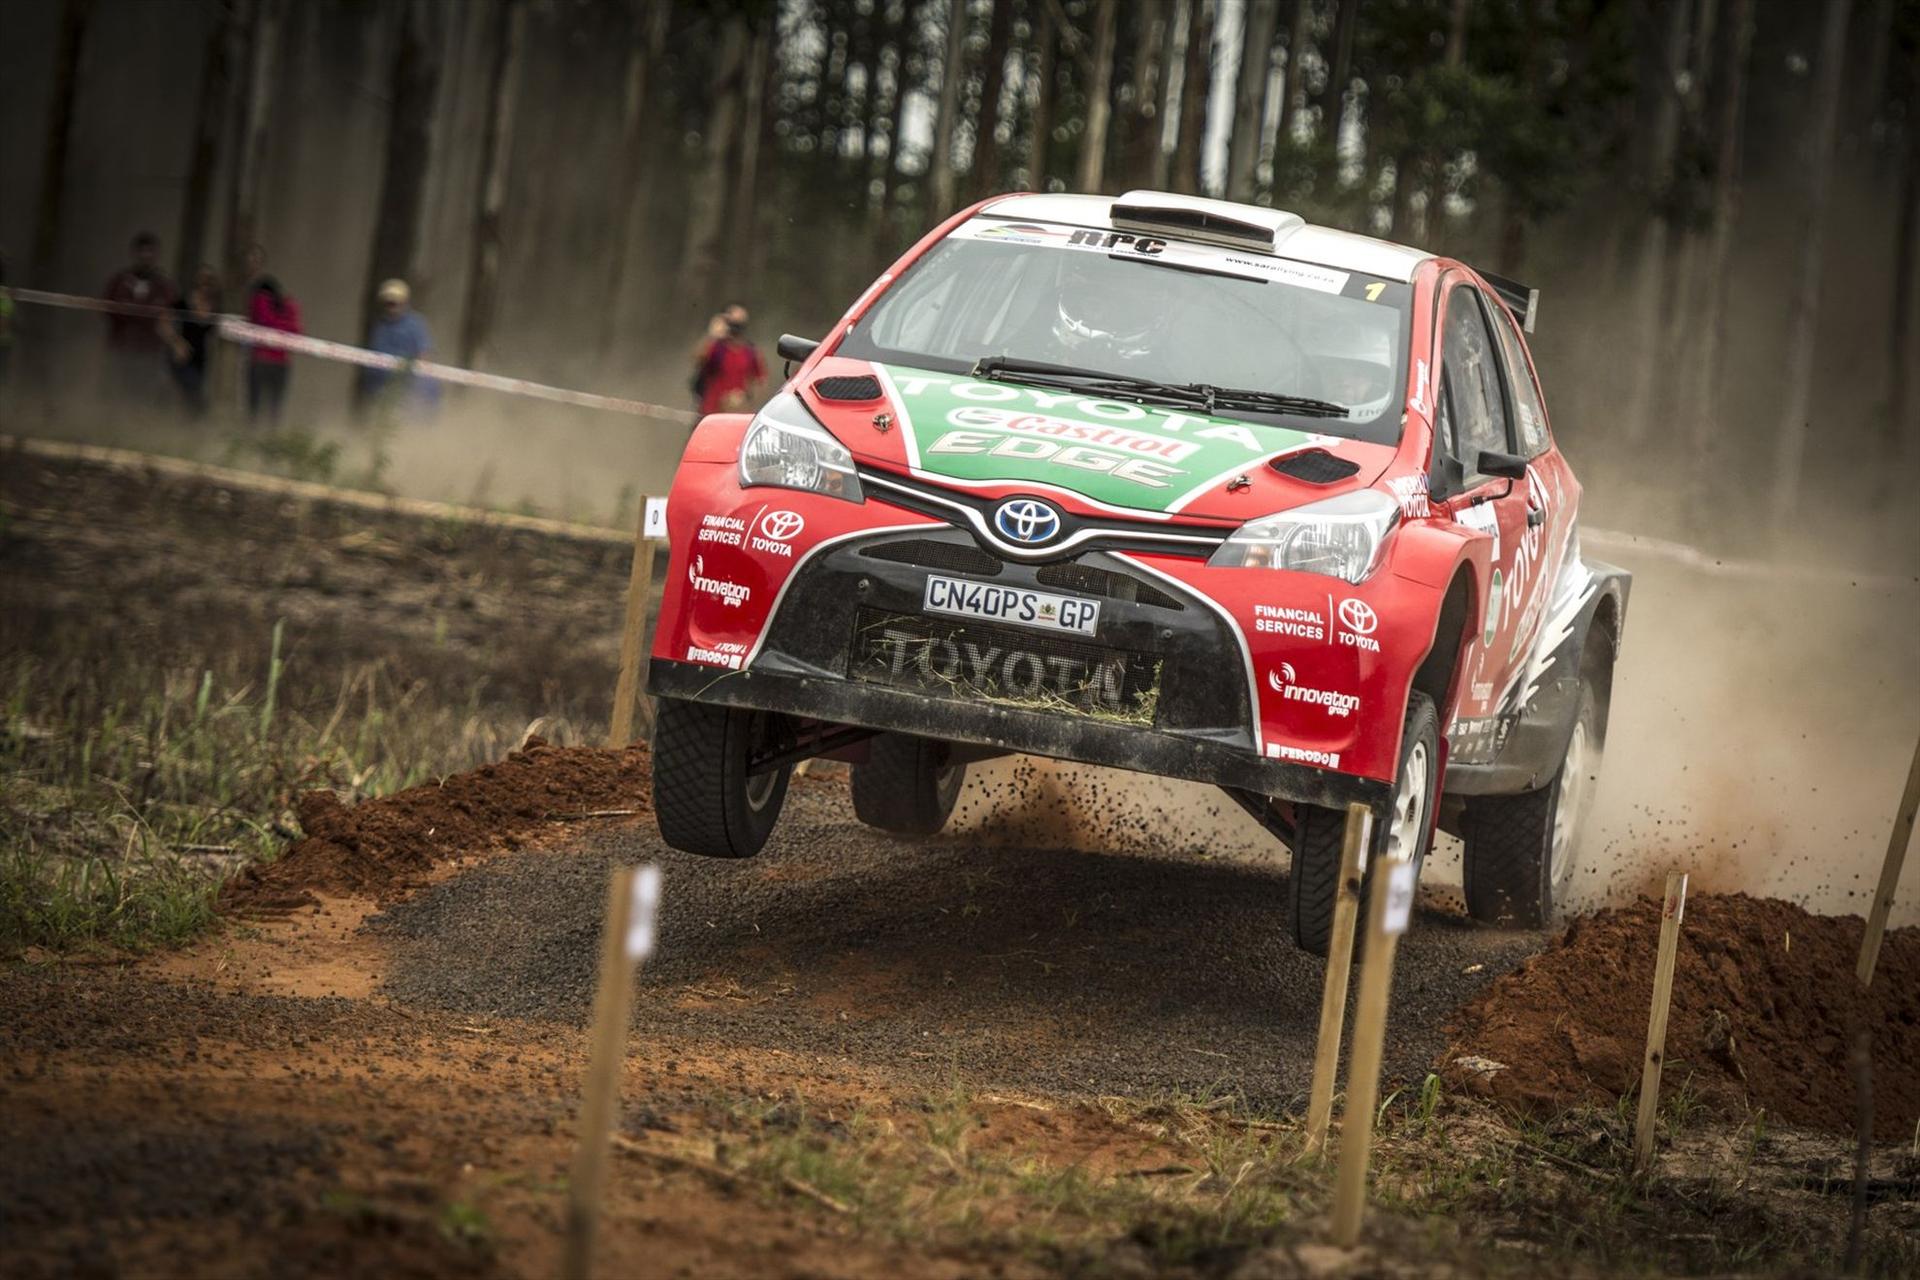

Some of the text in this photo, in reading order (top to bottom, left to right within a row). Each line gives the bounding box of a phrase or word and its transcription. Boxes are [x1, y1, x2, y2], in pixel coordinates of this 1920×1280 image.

[1364, 282, 1387, 302] 1
[893, 375, 1264, 452] TOYOTA
[1006, 414, 1184, 458] Castrol
[927, 430, 1191, 488] EDGE
[702, 515, 745, 531] FINANCIAL
[698, 529, 741, 546] SERVICES
[751, 537, 792, 558] TOYOTA
[694, 576, 750, 601] innovation
[723, 596, 742, 608] group
[1059, 599, 1096, 630] GP
[1254, 605, 1324, 625] FINANCIAL
[1255, 619, 1324, 640] SERVICES
[1338, 631, 1380, 652] TOYOTA
[884, 629, 1126, 710] TOYOTA
[1284, 685, 1359, 710] innovation
[1328, 705, 1349, 718] group
[1280, 747, 1329, 766] FERODO
